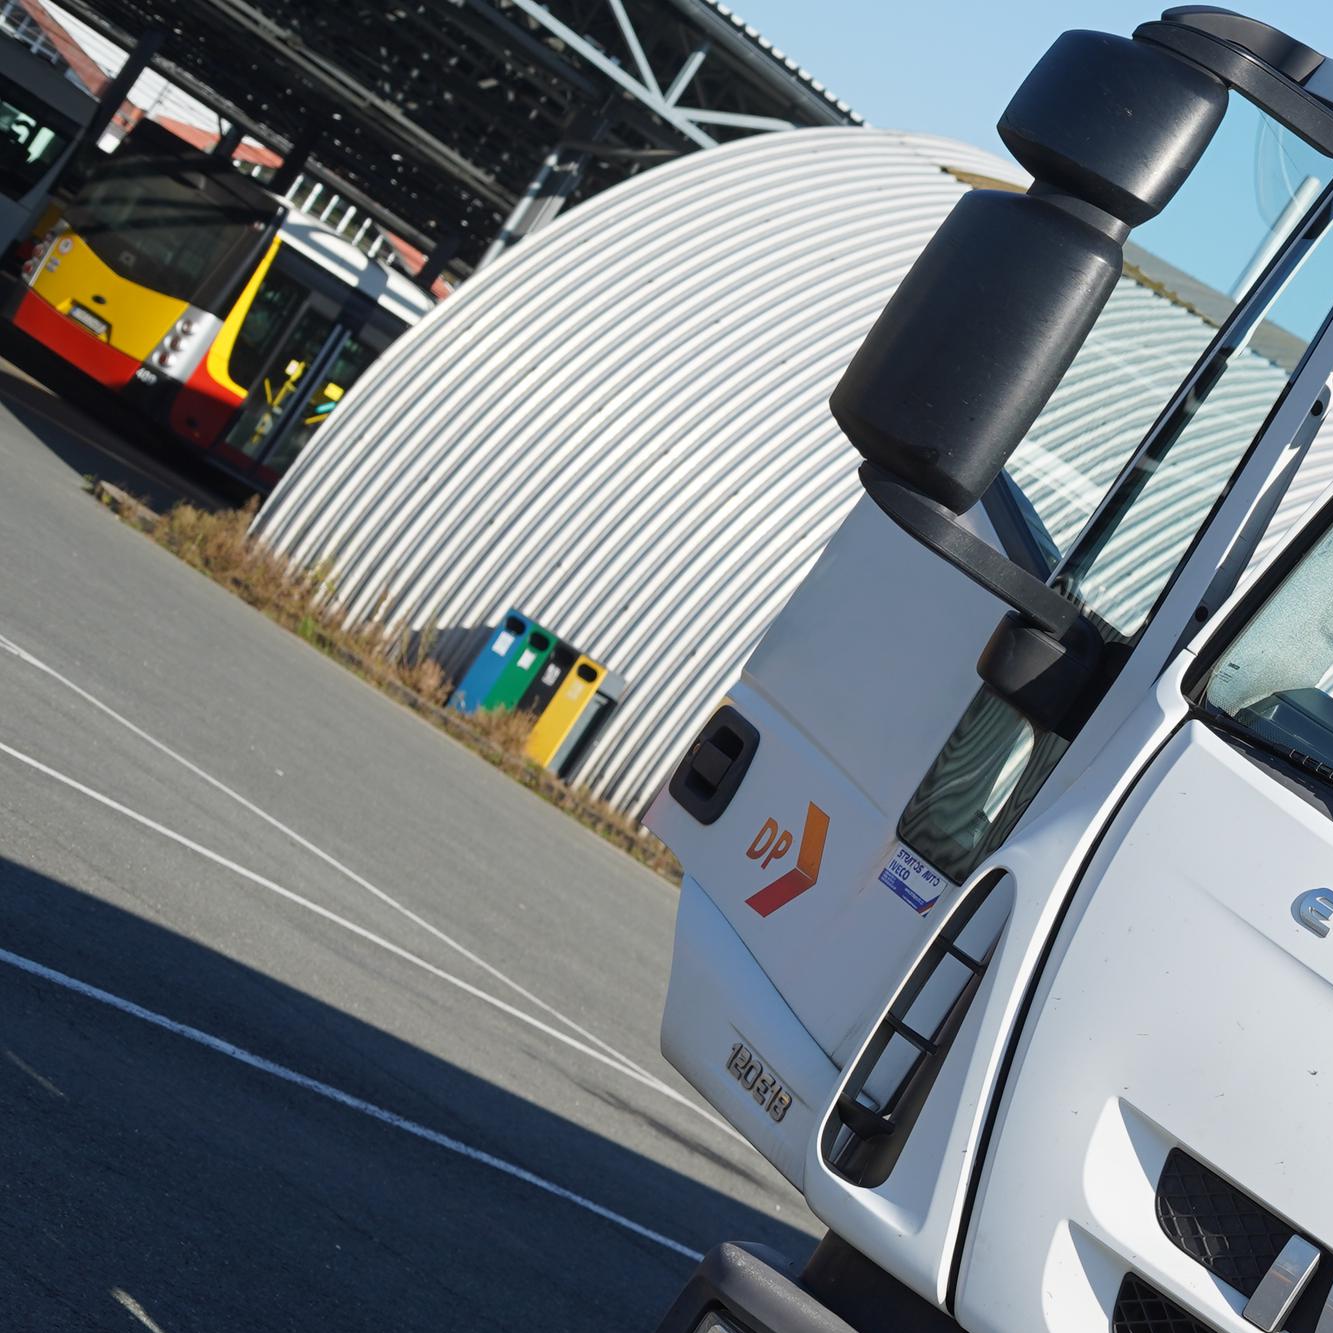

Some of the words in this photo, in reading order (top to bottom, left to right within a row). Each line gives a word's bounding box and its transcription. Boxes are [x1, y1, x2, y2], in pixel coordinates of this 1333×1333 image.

[745, 816, 793, 871] DP
[888, 859, 911, 881] IVECO
[921, 870, 941, 887] AUTO
